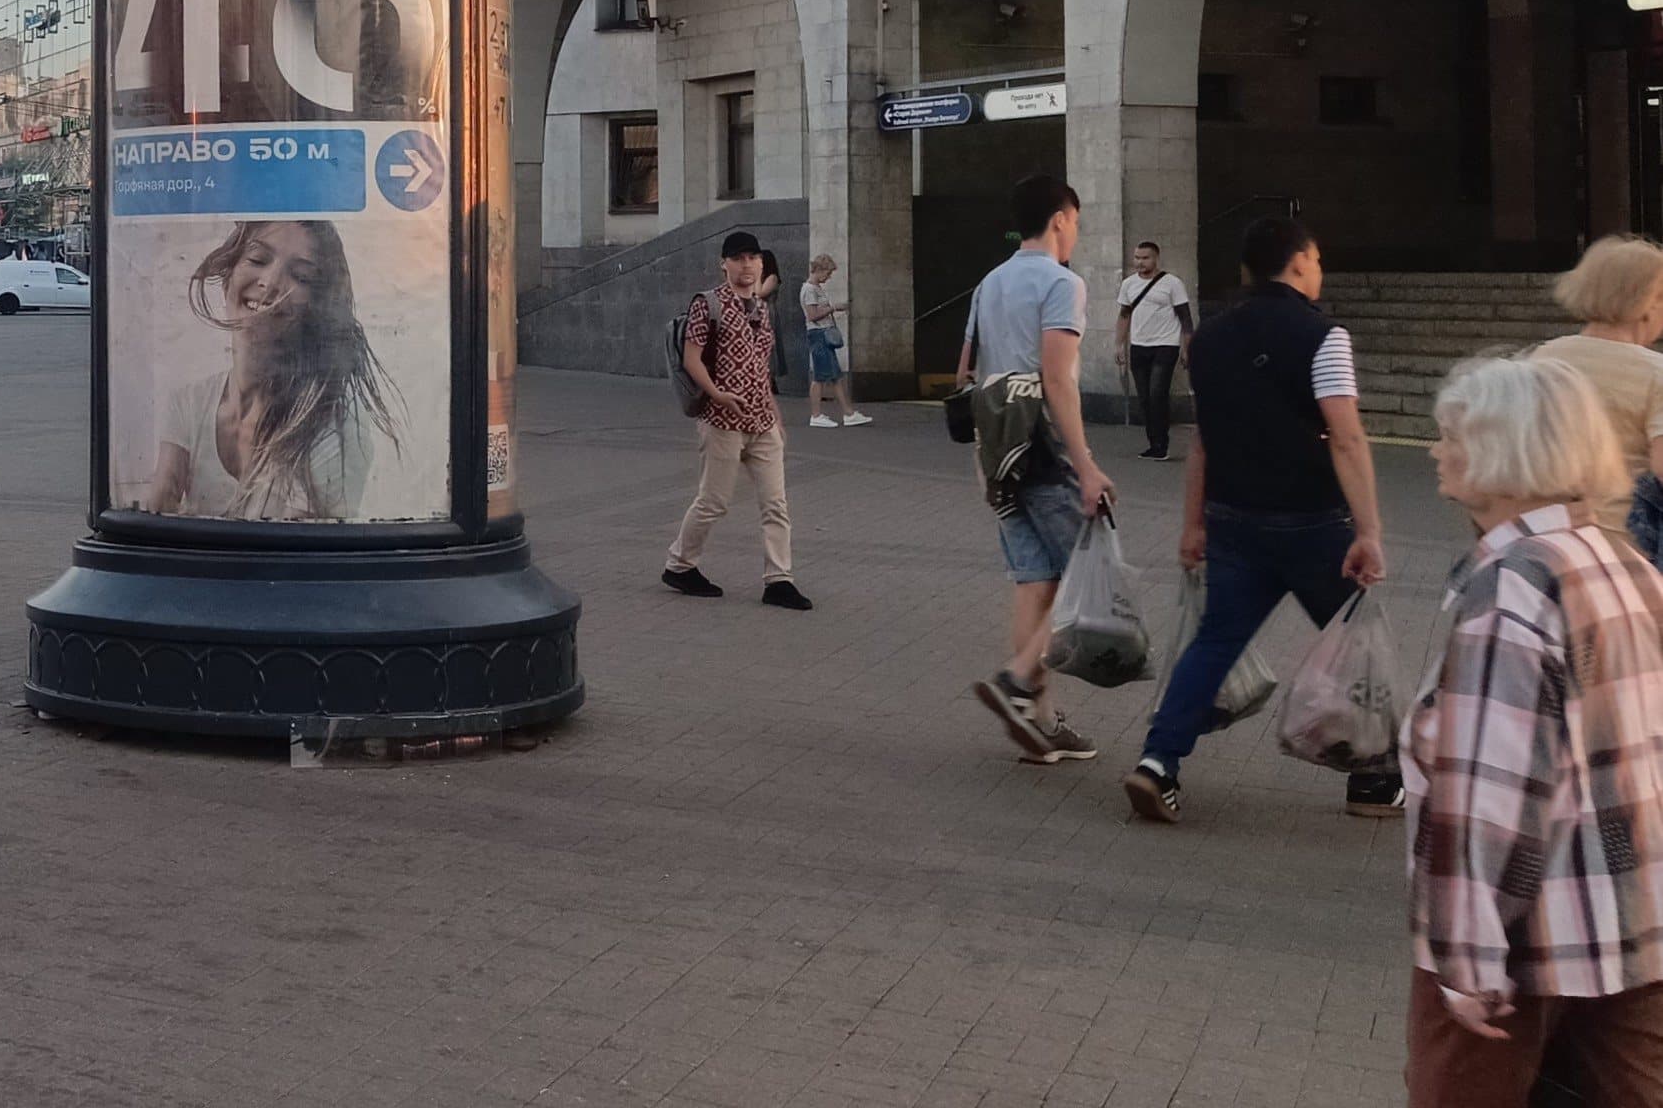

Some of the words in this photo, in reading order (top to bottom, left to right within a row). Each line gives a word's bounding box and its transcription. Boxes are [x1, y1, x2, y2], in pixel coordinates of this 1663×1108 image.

[115, 139, 236, 166] НАПРАВО
[249, 137, 298, 161] 50
[205, 178, 215, 189] 4
